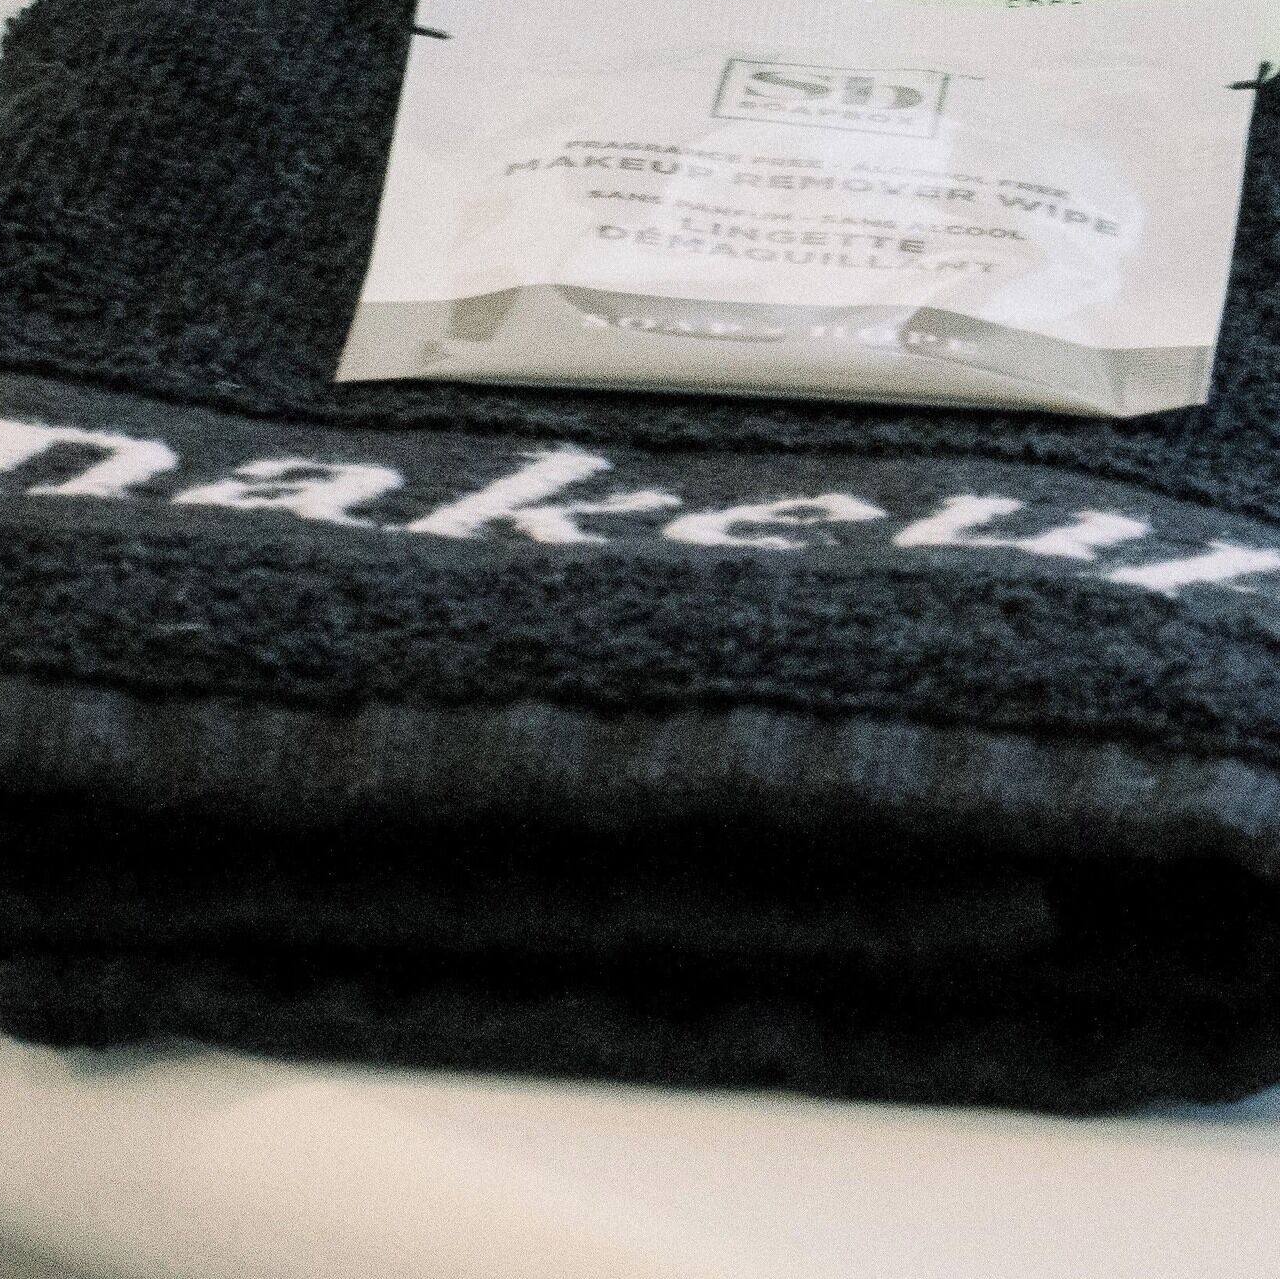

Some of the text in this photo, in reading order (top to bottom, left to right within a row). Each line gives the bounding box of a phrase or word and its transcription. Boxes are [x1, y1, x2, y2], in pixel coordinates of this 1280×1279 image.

[736, 99, 916, 125] SOAPBOX
[502, 152, 1119, 238] MAKEUP REMOVER WIPE
[750, 154, 824, 170] FREE
[996, 177, 1071, 202] FREE
[586, 189, 663, 206] SANS
[820, 214, 898, 231] SANS
[907, 221, 1028, 243] ALCOOL
[680, 216, 927, 256] LINGETTE
[594, 223, 1000, 275] DÉMAQUILLANT
